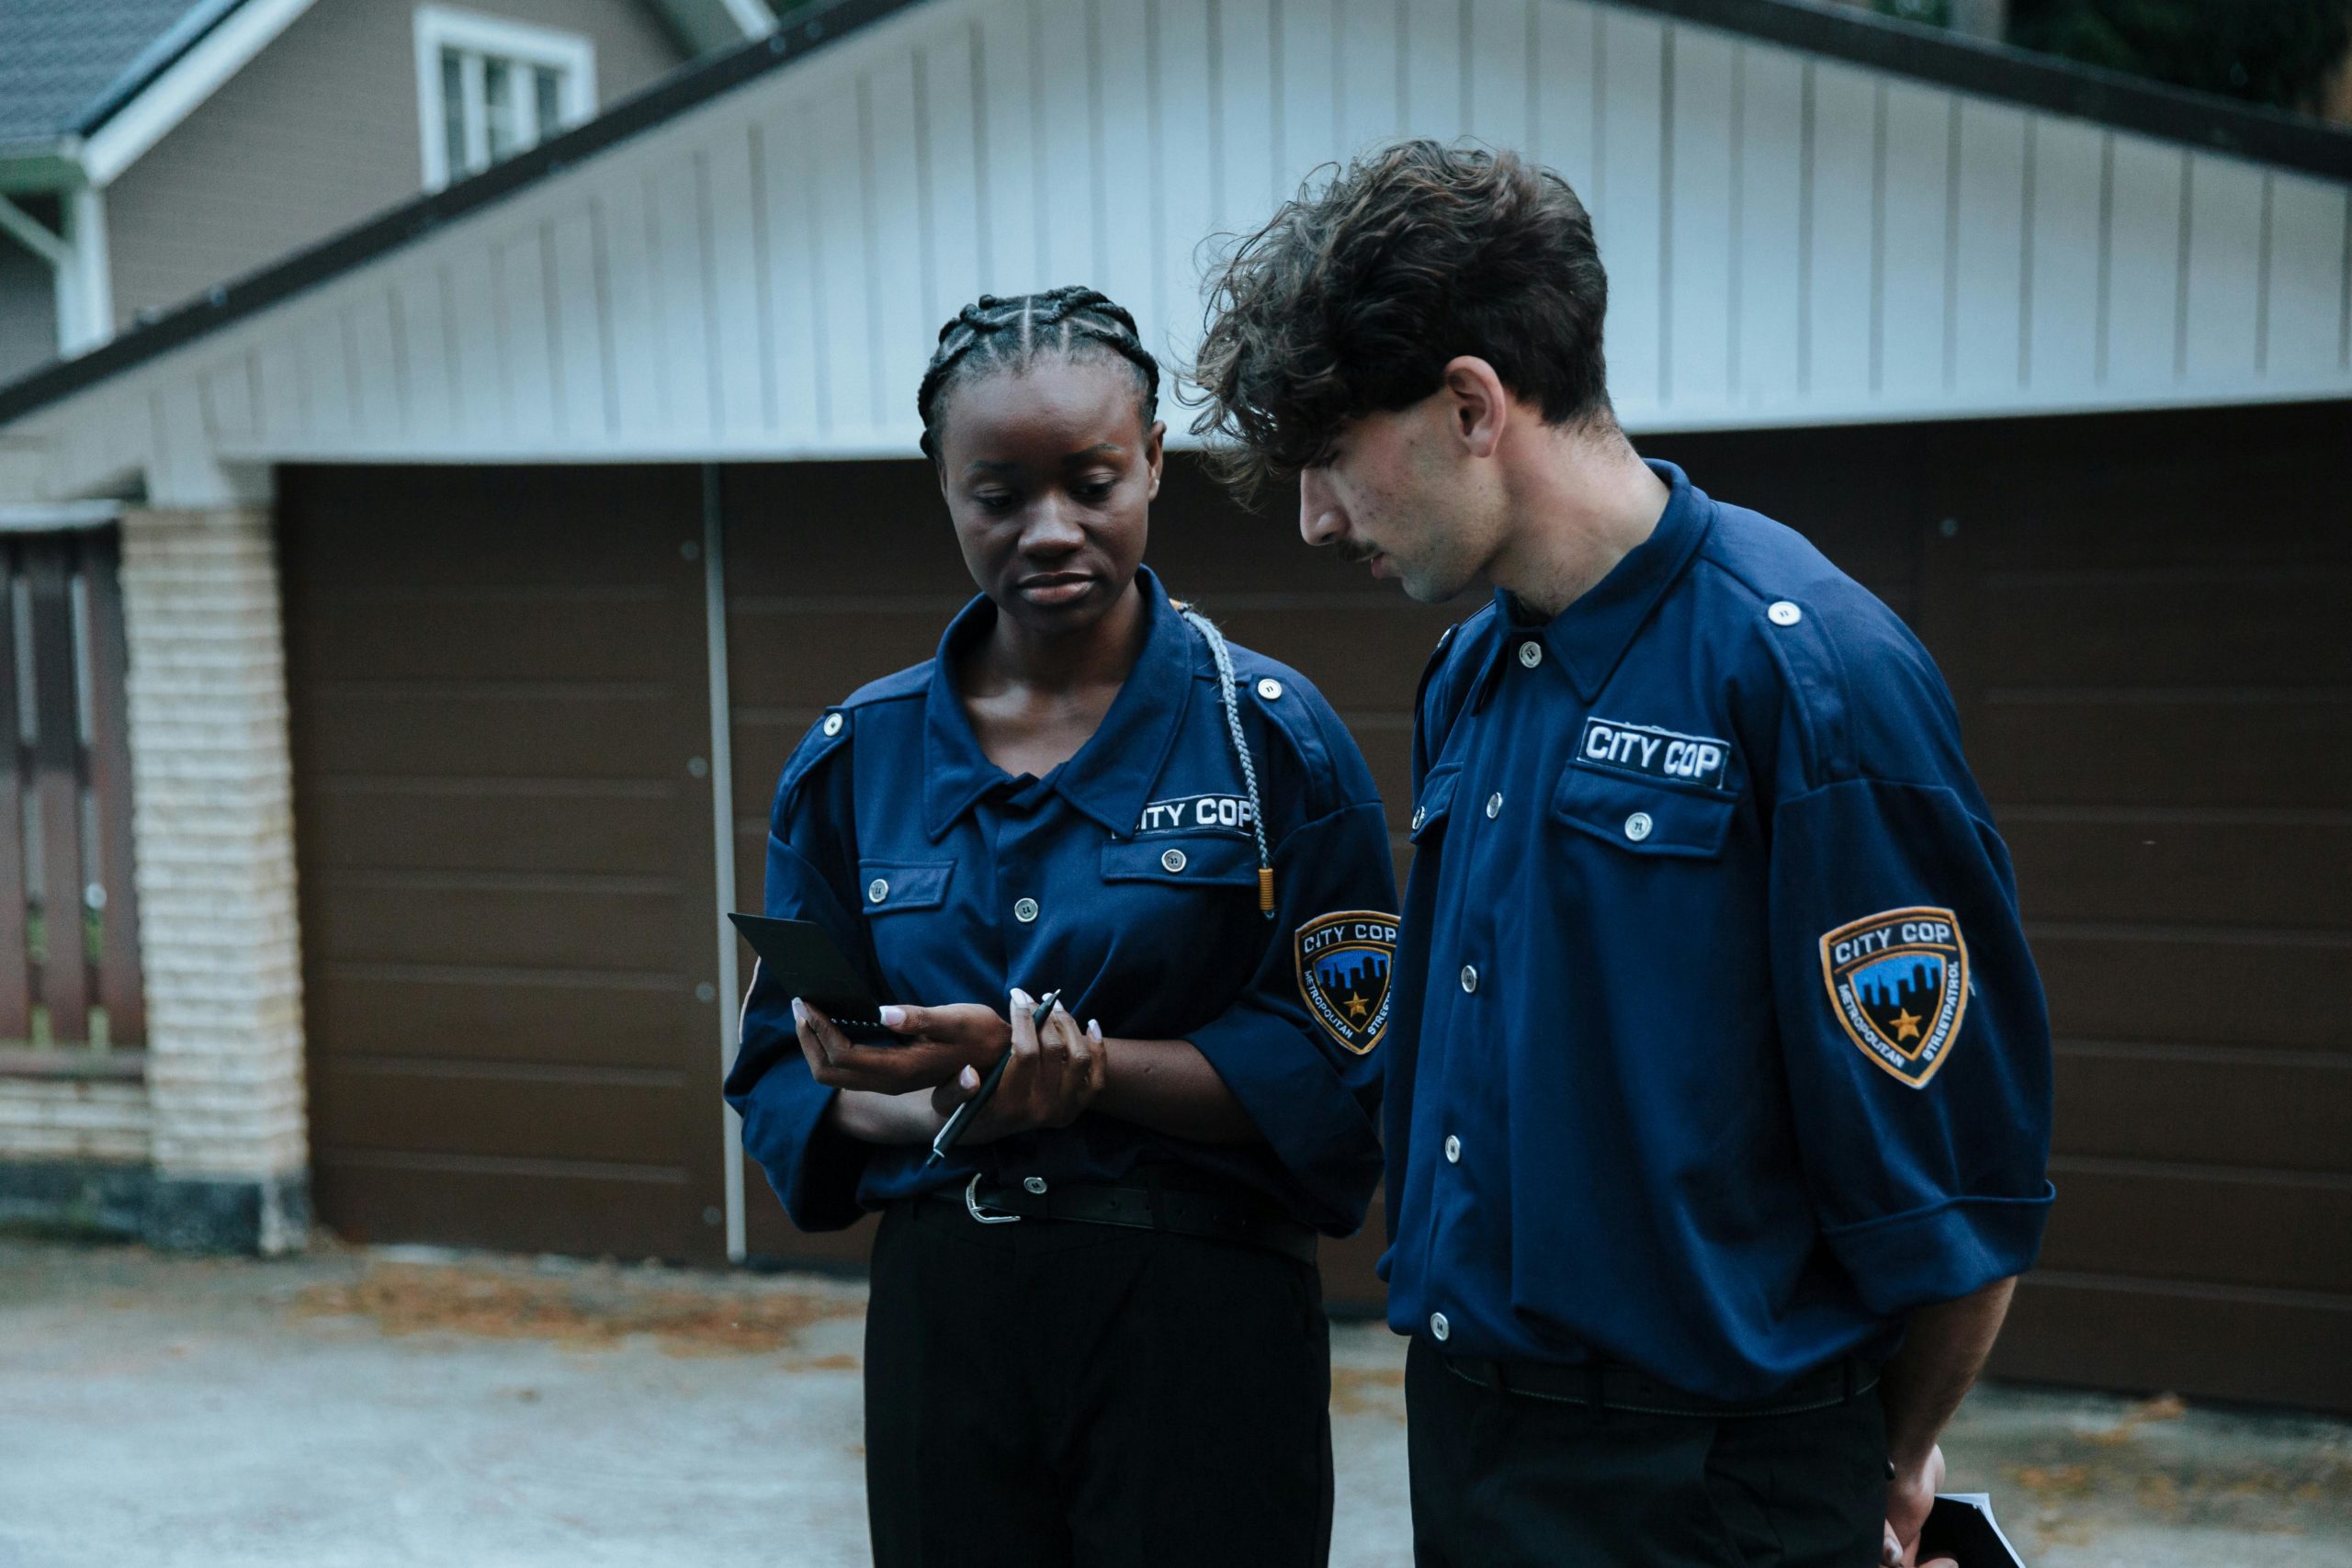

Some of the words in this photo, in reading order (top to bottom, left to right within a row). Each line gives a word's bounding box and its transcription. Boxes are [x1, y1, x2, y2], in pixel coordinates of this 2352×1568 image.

[1586, 726, 1662, 768] CITY
[1663, 740, 1722, 778] COP
[1135, 803, 1185, 830] ITY
[1195, 797, 1252, 828] COP
[1304, 926, 1345, 953] CITY
[1354, 924, 1396, 942] COP
[1835, 928, 1892, 964] CITY
[1901, 922, 1951, 943] COP
[1304, 970, 1353, 1039] METROPOLITAN
[1838, 983, 1906, 1068] METROPOLITAN
